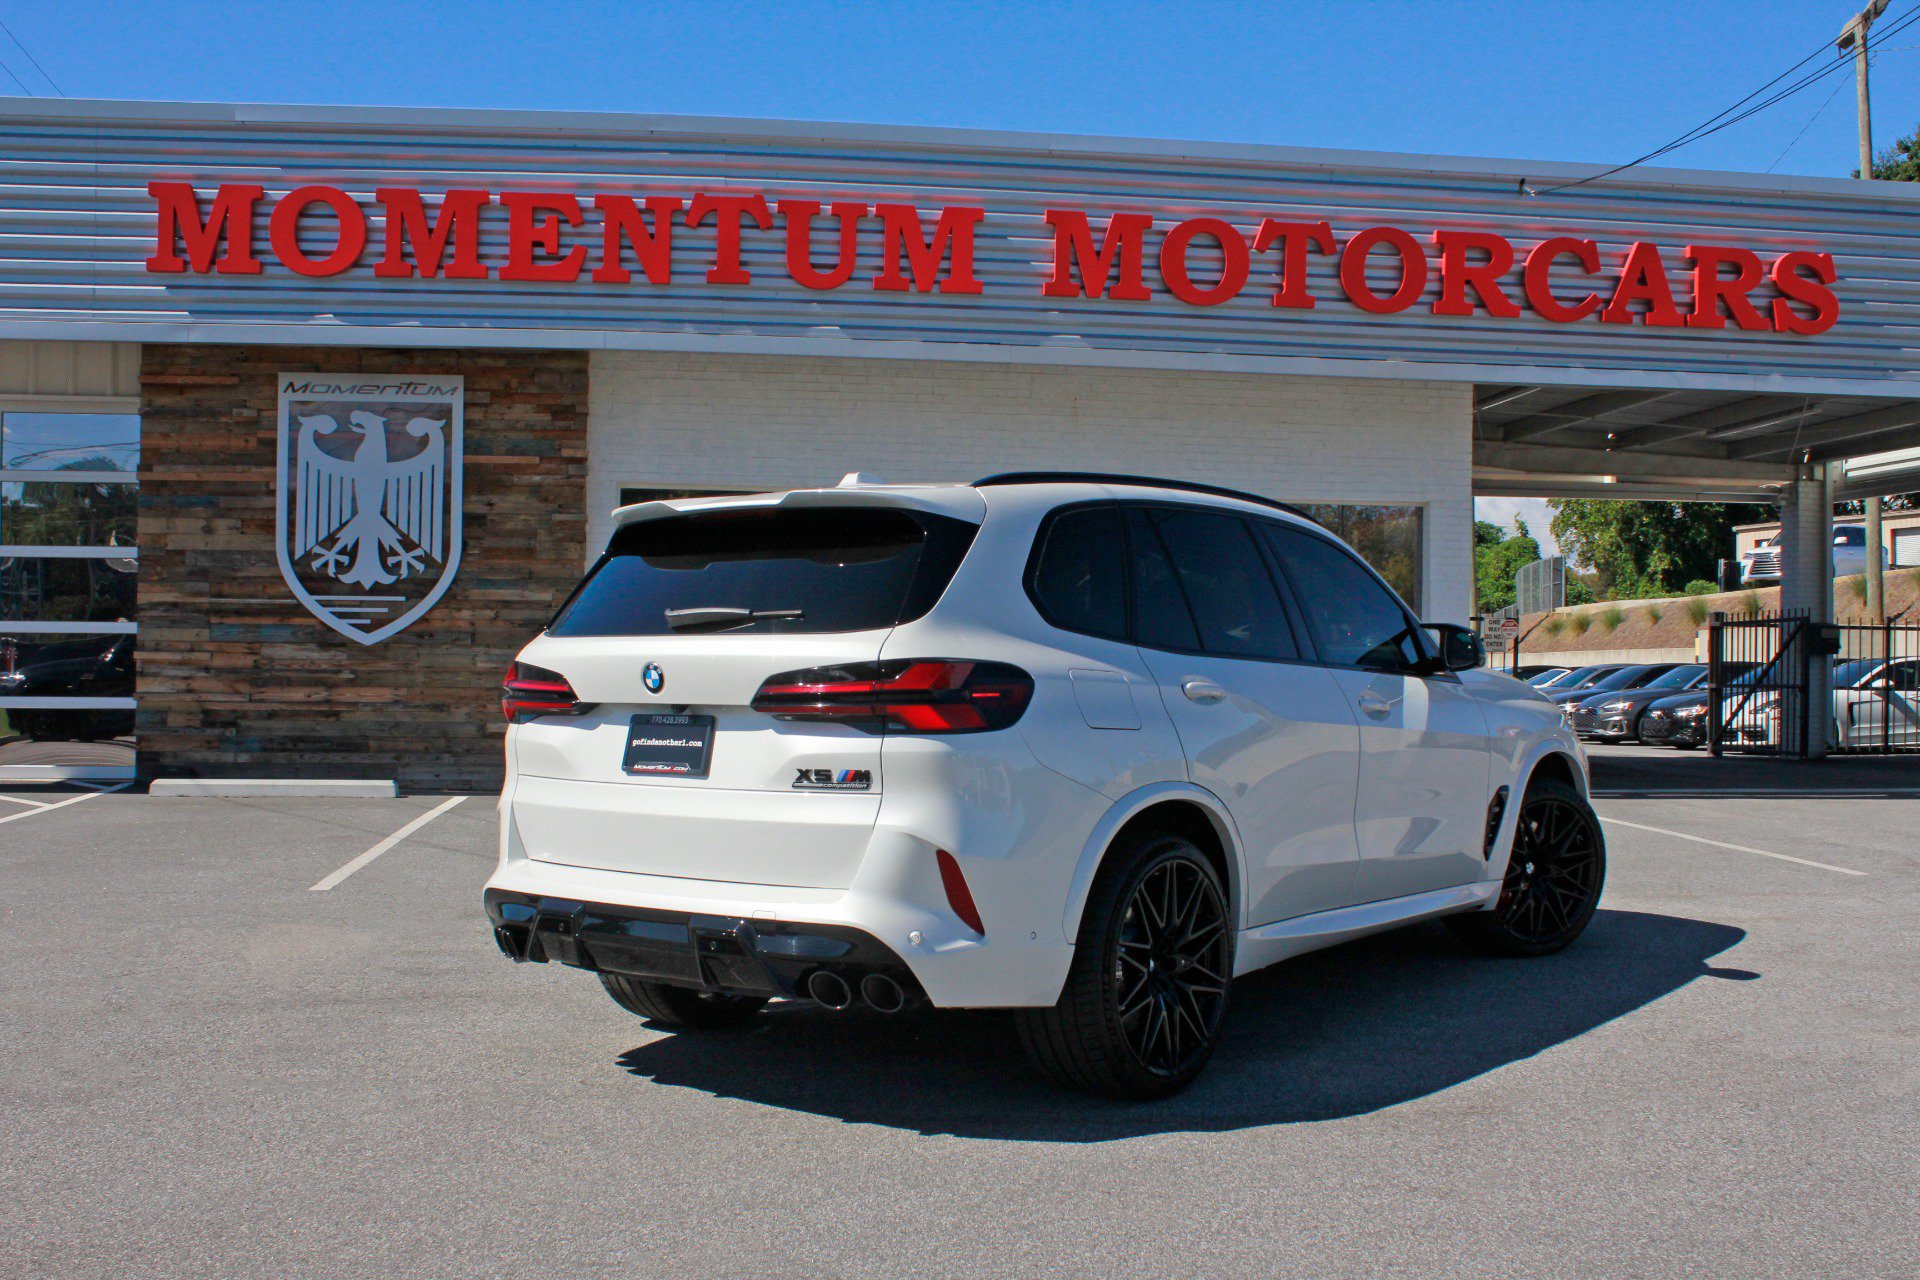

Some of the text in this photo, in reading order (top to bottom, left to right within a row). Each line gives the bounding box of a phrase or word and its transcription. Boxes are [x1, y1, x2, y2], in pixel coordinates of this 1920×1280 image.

[146, 181, 1841, 335] MOMENTUM MOTORCARS
[632, 738, 703, 747] gofindanother1.com
[795, 768, 833, 783] X5
[822, 782, 867, 790] competition
